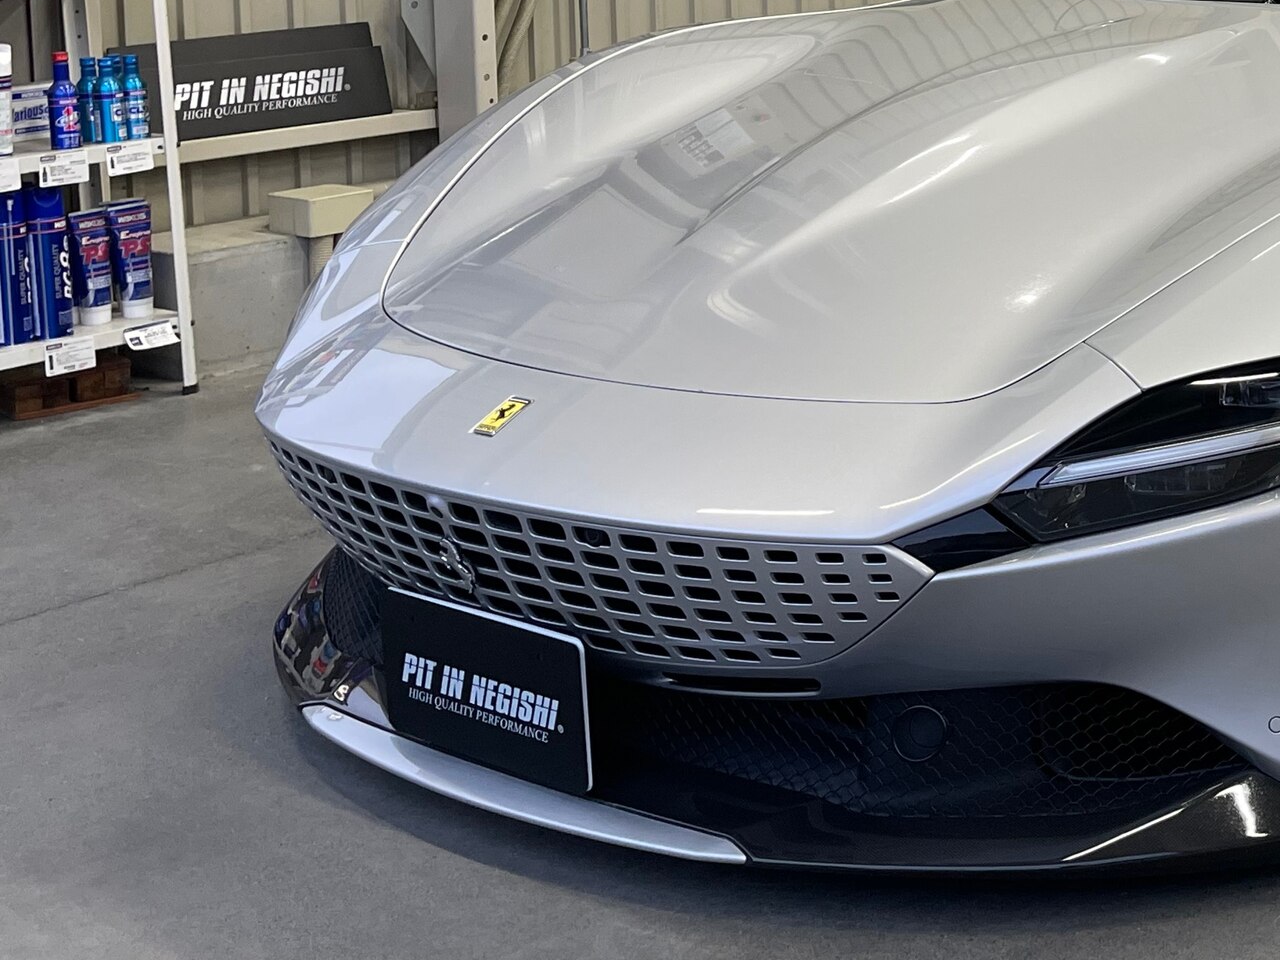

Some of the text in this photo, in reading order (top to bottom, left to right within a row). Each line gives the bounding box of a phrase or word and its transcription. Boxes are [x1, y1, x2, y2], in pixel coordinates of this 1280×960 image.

[174, 66, 345, 111] PIT IN NEGISHI
[183, 93, 338, 121] HIGH QUALITY PERFORMANCE
[12, 104, 44, 123] arious
[401, 652, 560, 731] PIT IN NEGISHI
[408, 687, 549, 743] HIGH QUALITY PERFORMANCE
